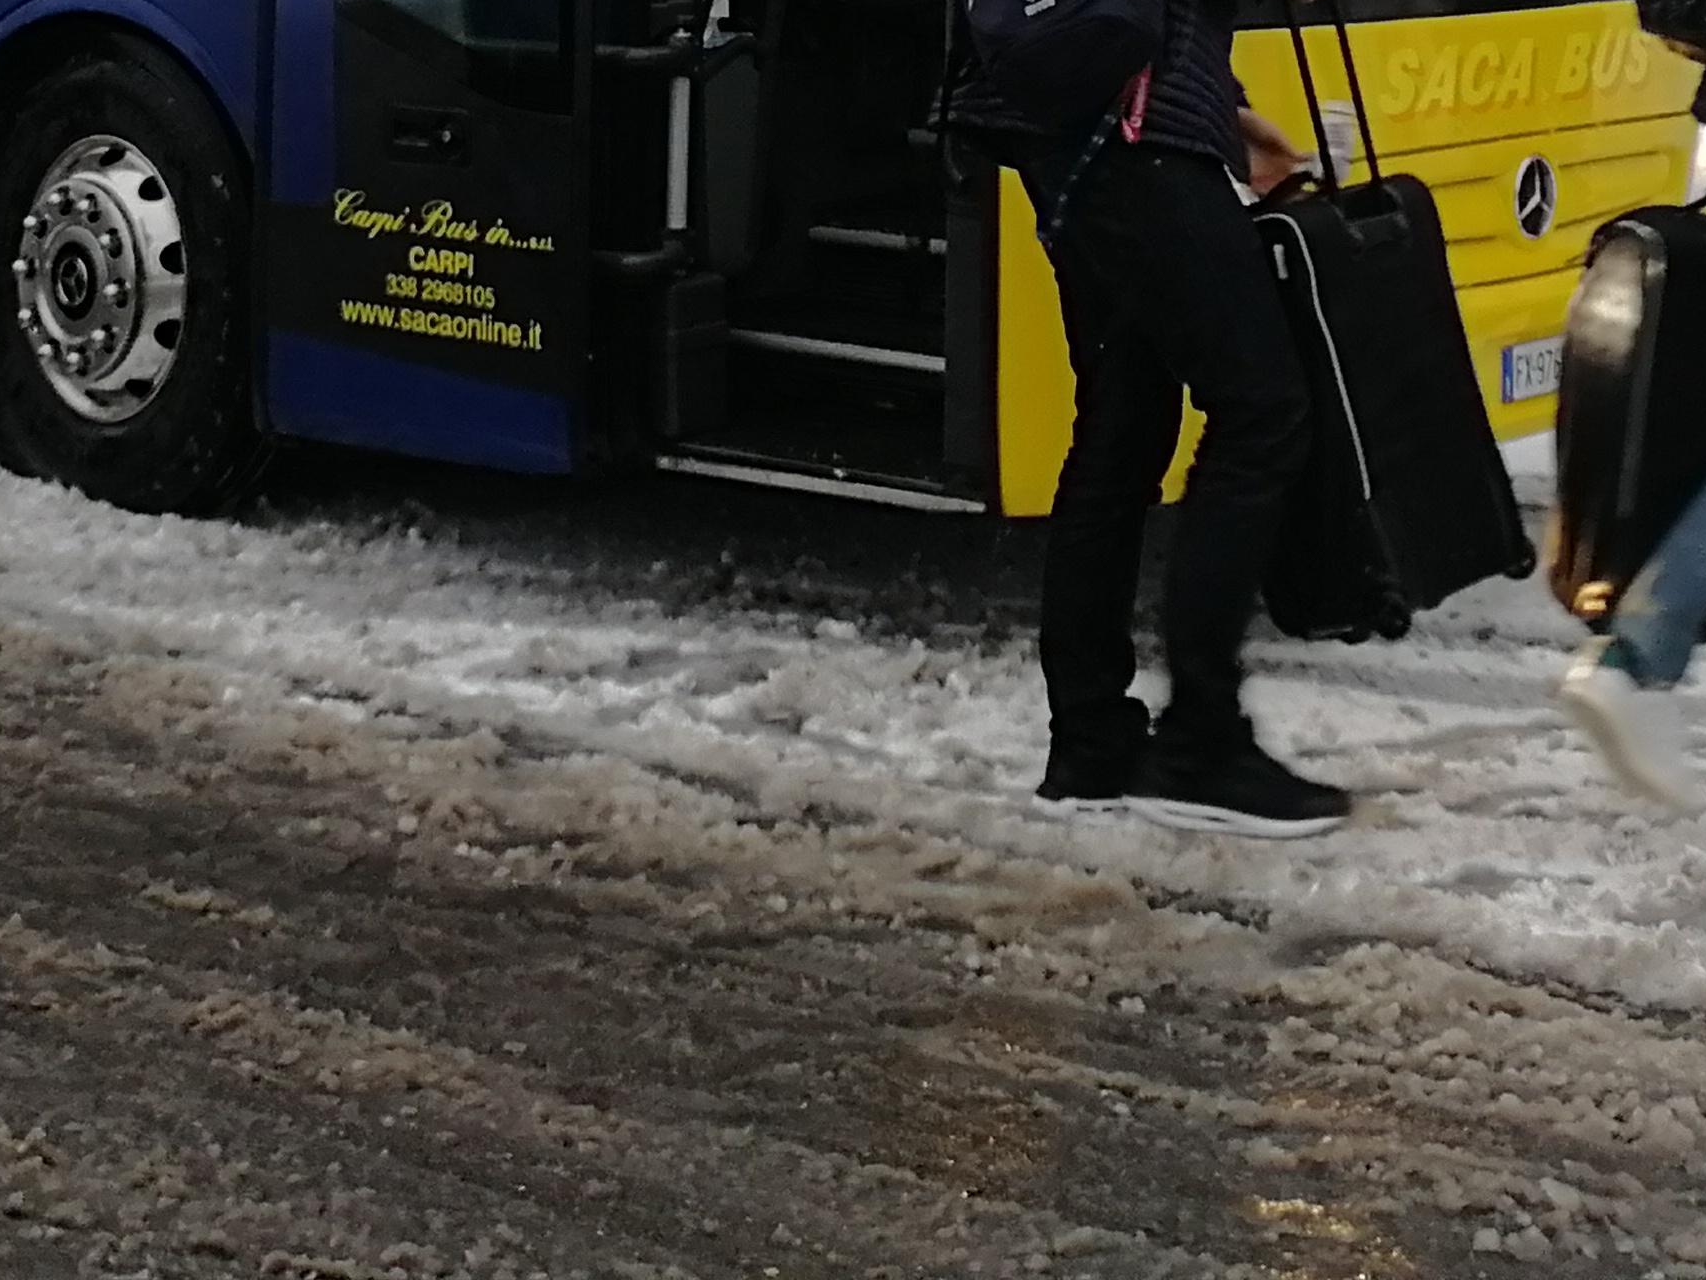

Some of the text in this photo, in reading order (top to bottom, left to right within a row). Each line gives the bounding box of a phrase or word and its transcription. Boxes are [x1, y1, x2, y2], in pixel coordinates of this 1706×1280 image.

[1380, 28, 1650, 122] SACA BUS
[334, 188, 411, 239] Carpi
[410, 199, 481, 239] Bus
[409, 245, 475, 278] CARPI
[341, 298, 543, 351] www.sacaonline.it
